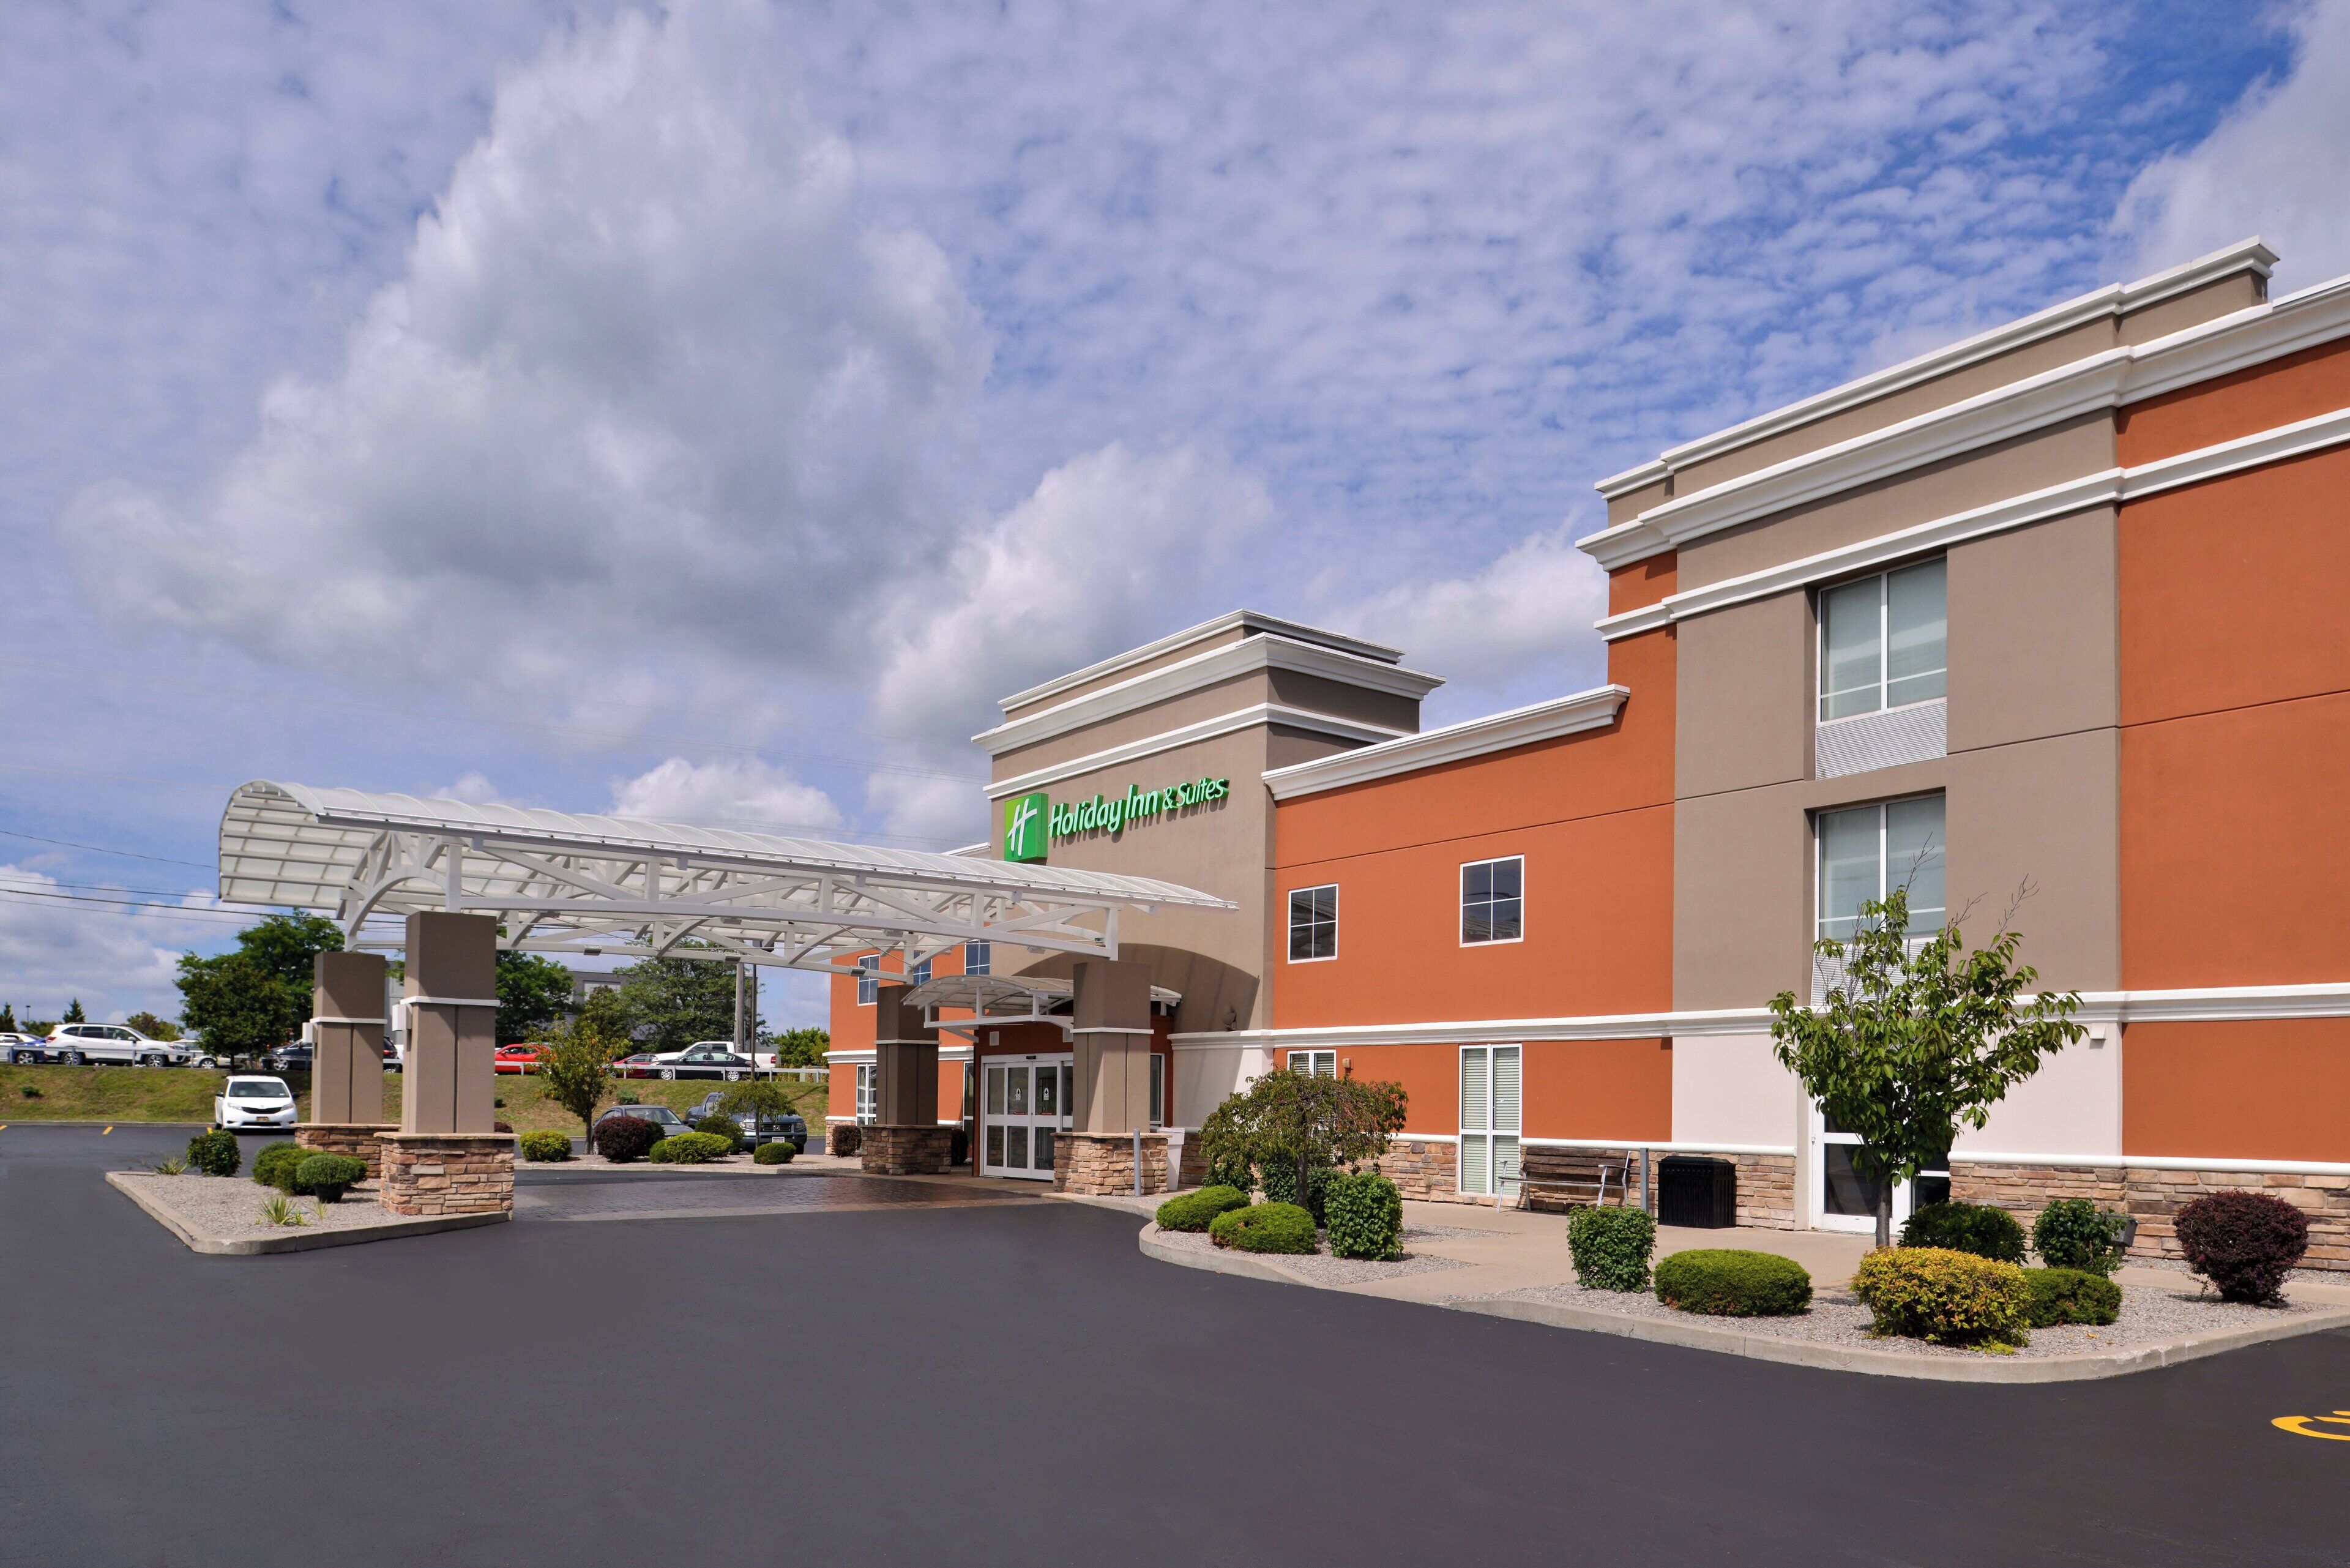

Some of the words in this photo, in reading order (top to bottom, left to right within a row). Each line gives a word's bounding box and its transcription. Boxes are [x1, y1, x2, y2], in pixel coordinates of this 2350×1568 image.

[1048, 794, 1125, 838] Holiday
[1125, 784, 1161, 819] Inn
[1163, 786, 1177, 810] &
[1176, 777, 1228, 807] Suites
